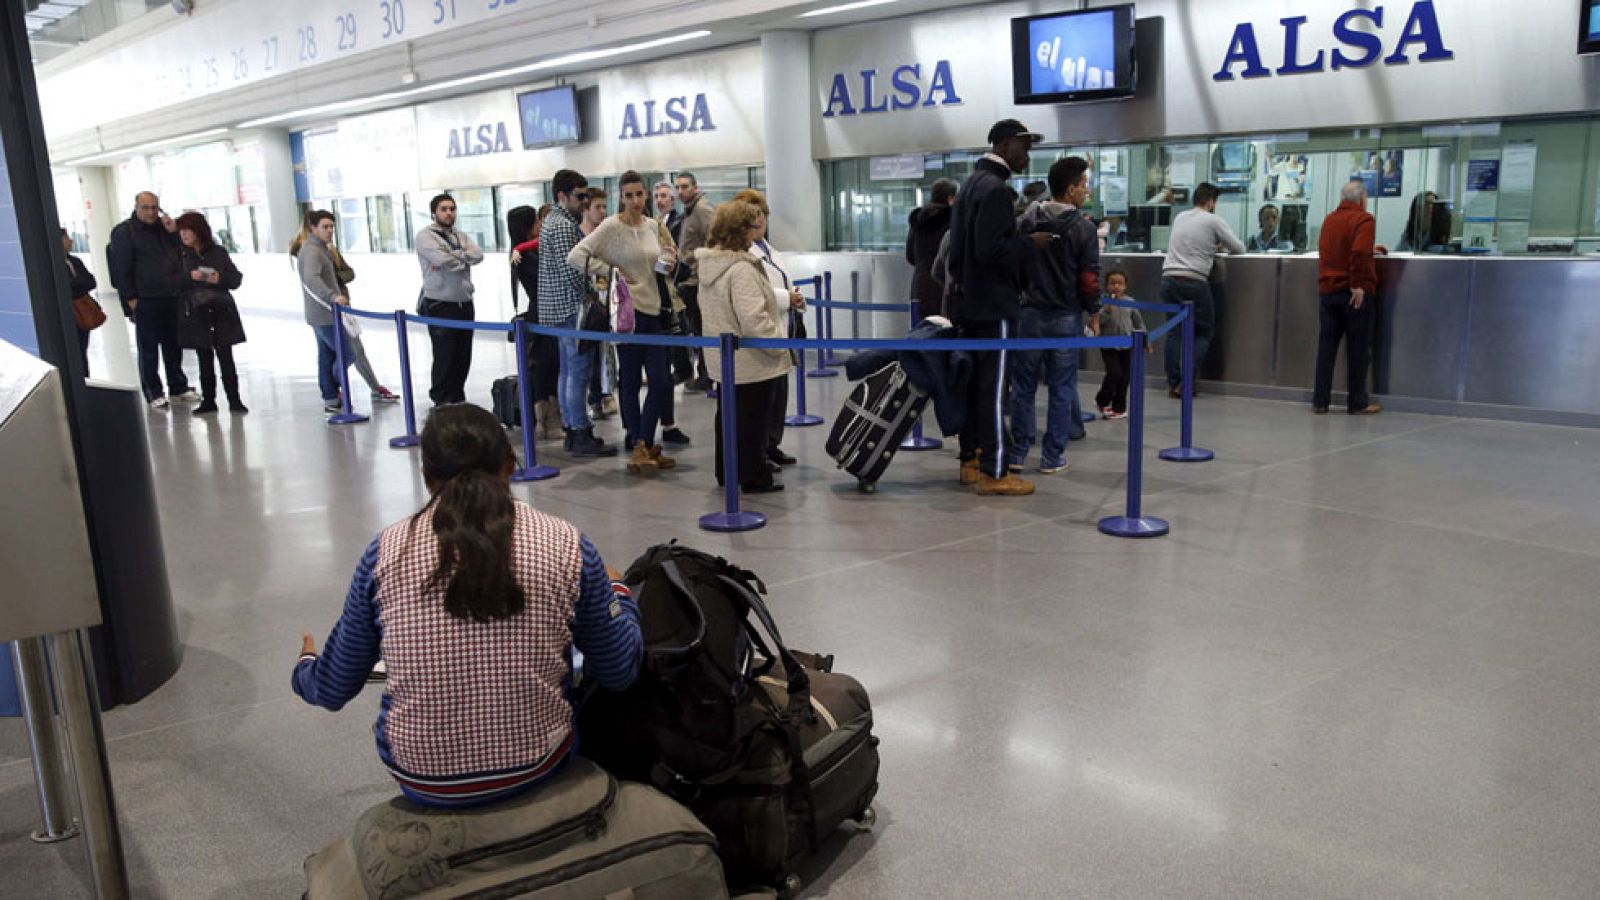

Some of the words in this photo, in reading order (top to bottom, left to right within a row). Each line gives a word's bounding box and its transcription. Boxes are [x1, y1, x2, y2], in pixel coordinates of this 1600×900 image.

[203, 57, 220, 88] 25
[231, 48, 249, 80] 26
[262, 36, 279, 71] 27
[297, 25, 318, 61] 28
[336, 13, 358, 50] 29
[380, 0, 405, 38] 30
[1212, 0, 1454, 80] ALSA
[619, 93, 716, 139] ALSA
[823, 59, 962, 117] ALSA
[447, 121, 511, 158] ALSA
